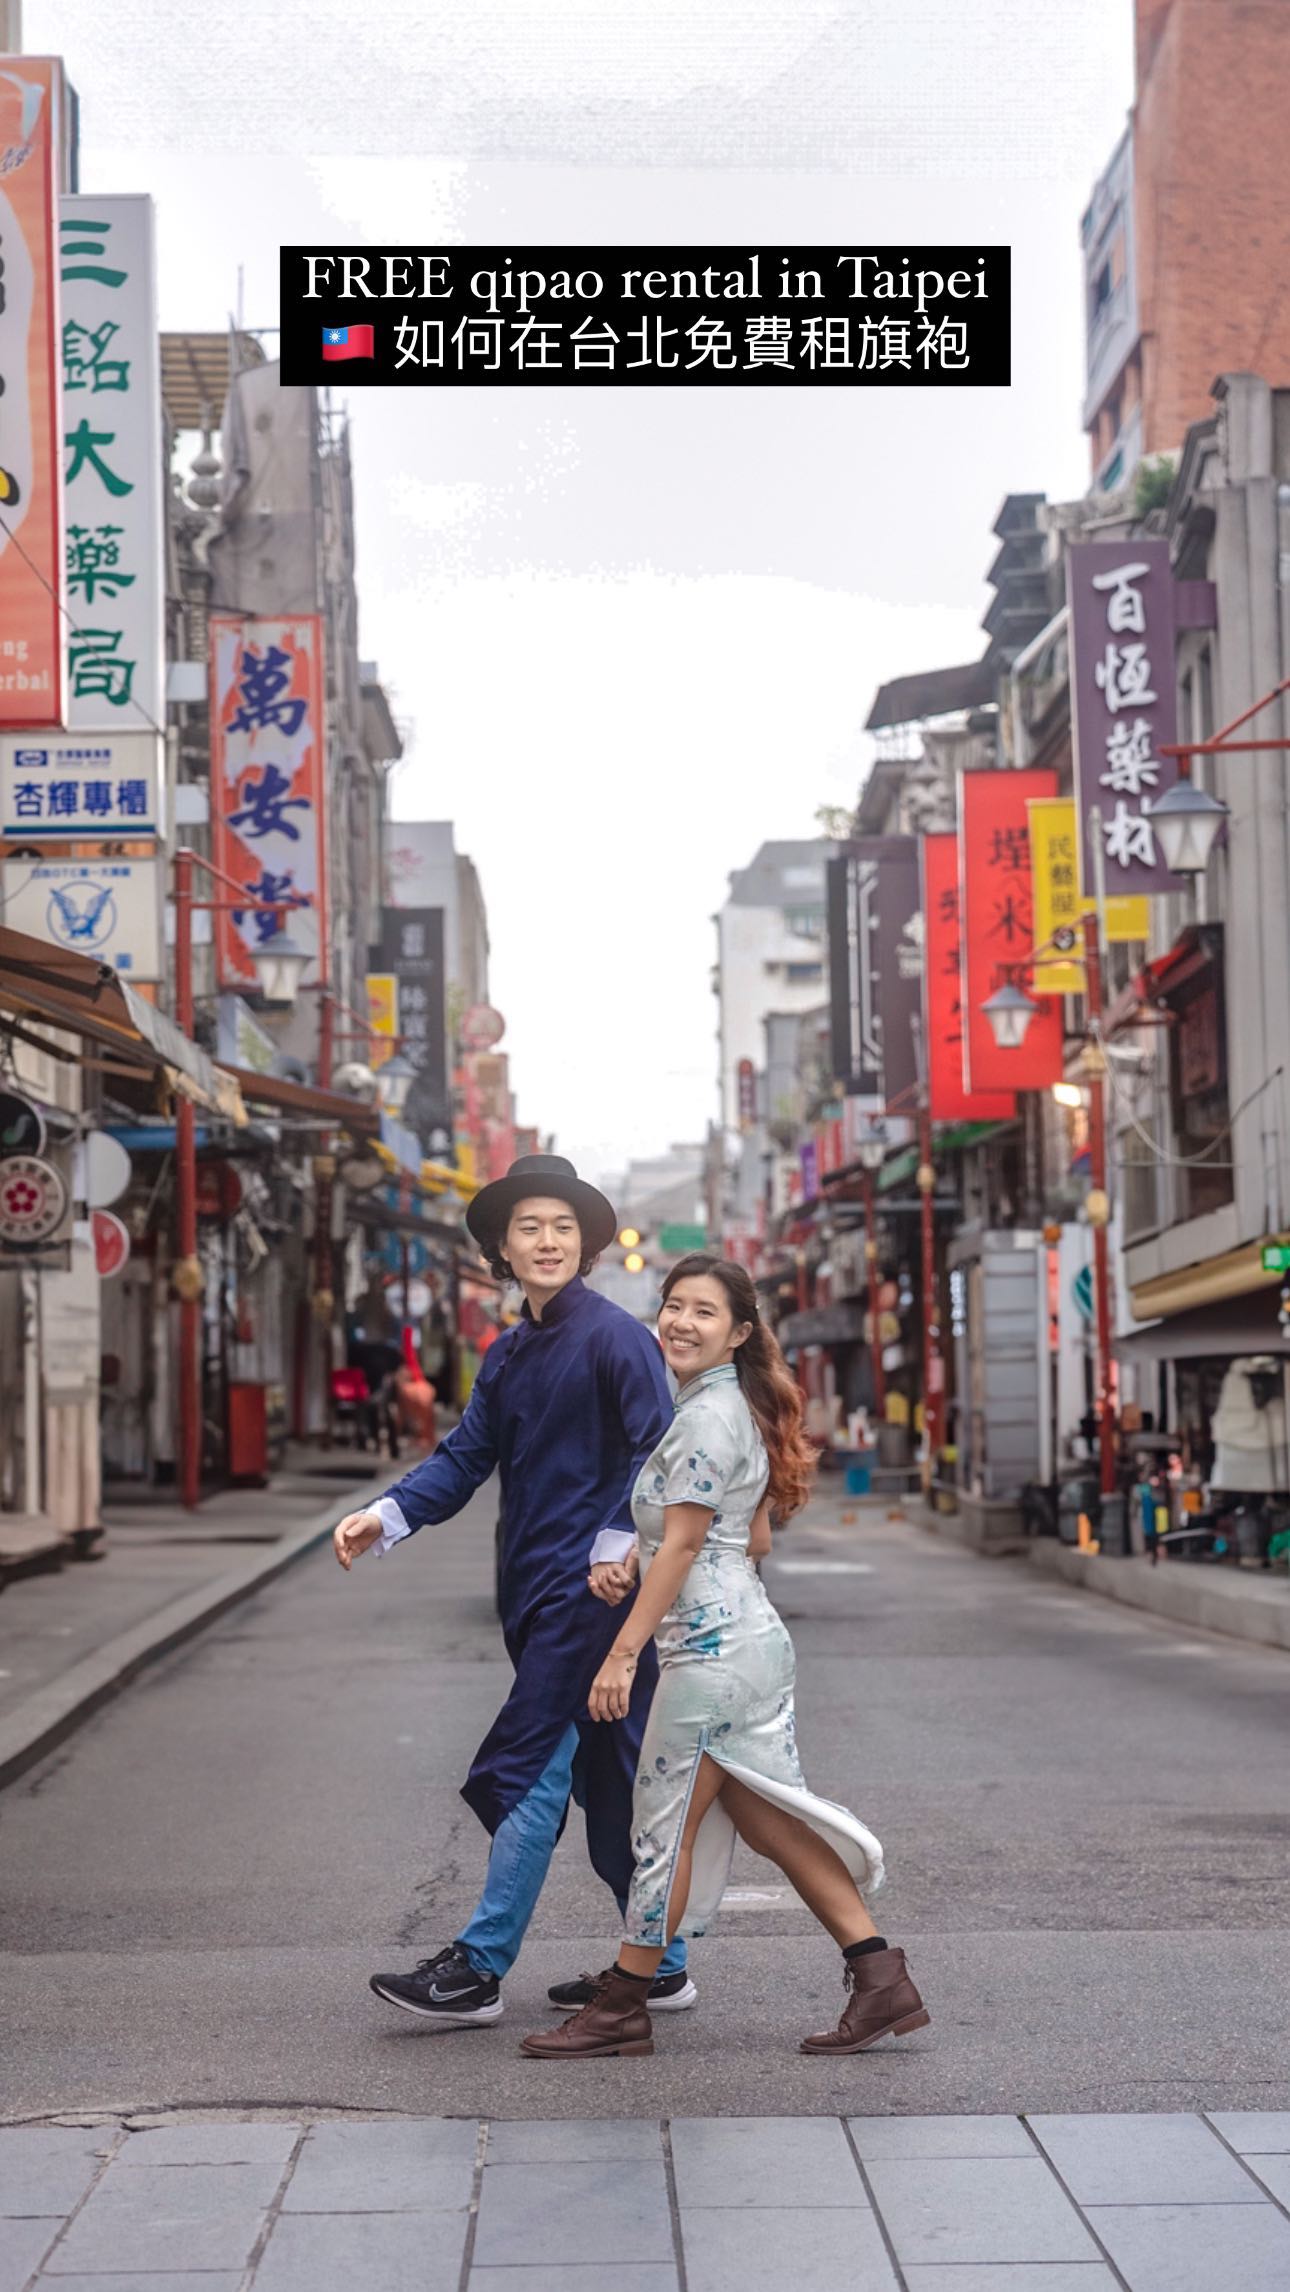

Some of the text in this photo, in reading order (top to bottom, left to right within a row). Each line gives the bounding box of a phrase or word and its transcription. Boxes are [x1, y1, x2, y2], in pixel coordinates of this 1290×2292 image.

[60, 219, 137, 706] 三銘大藥局
[14, 780, 147, 817] 杏輝專櫃
